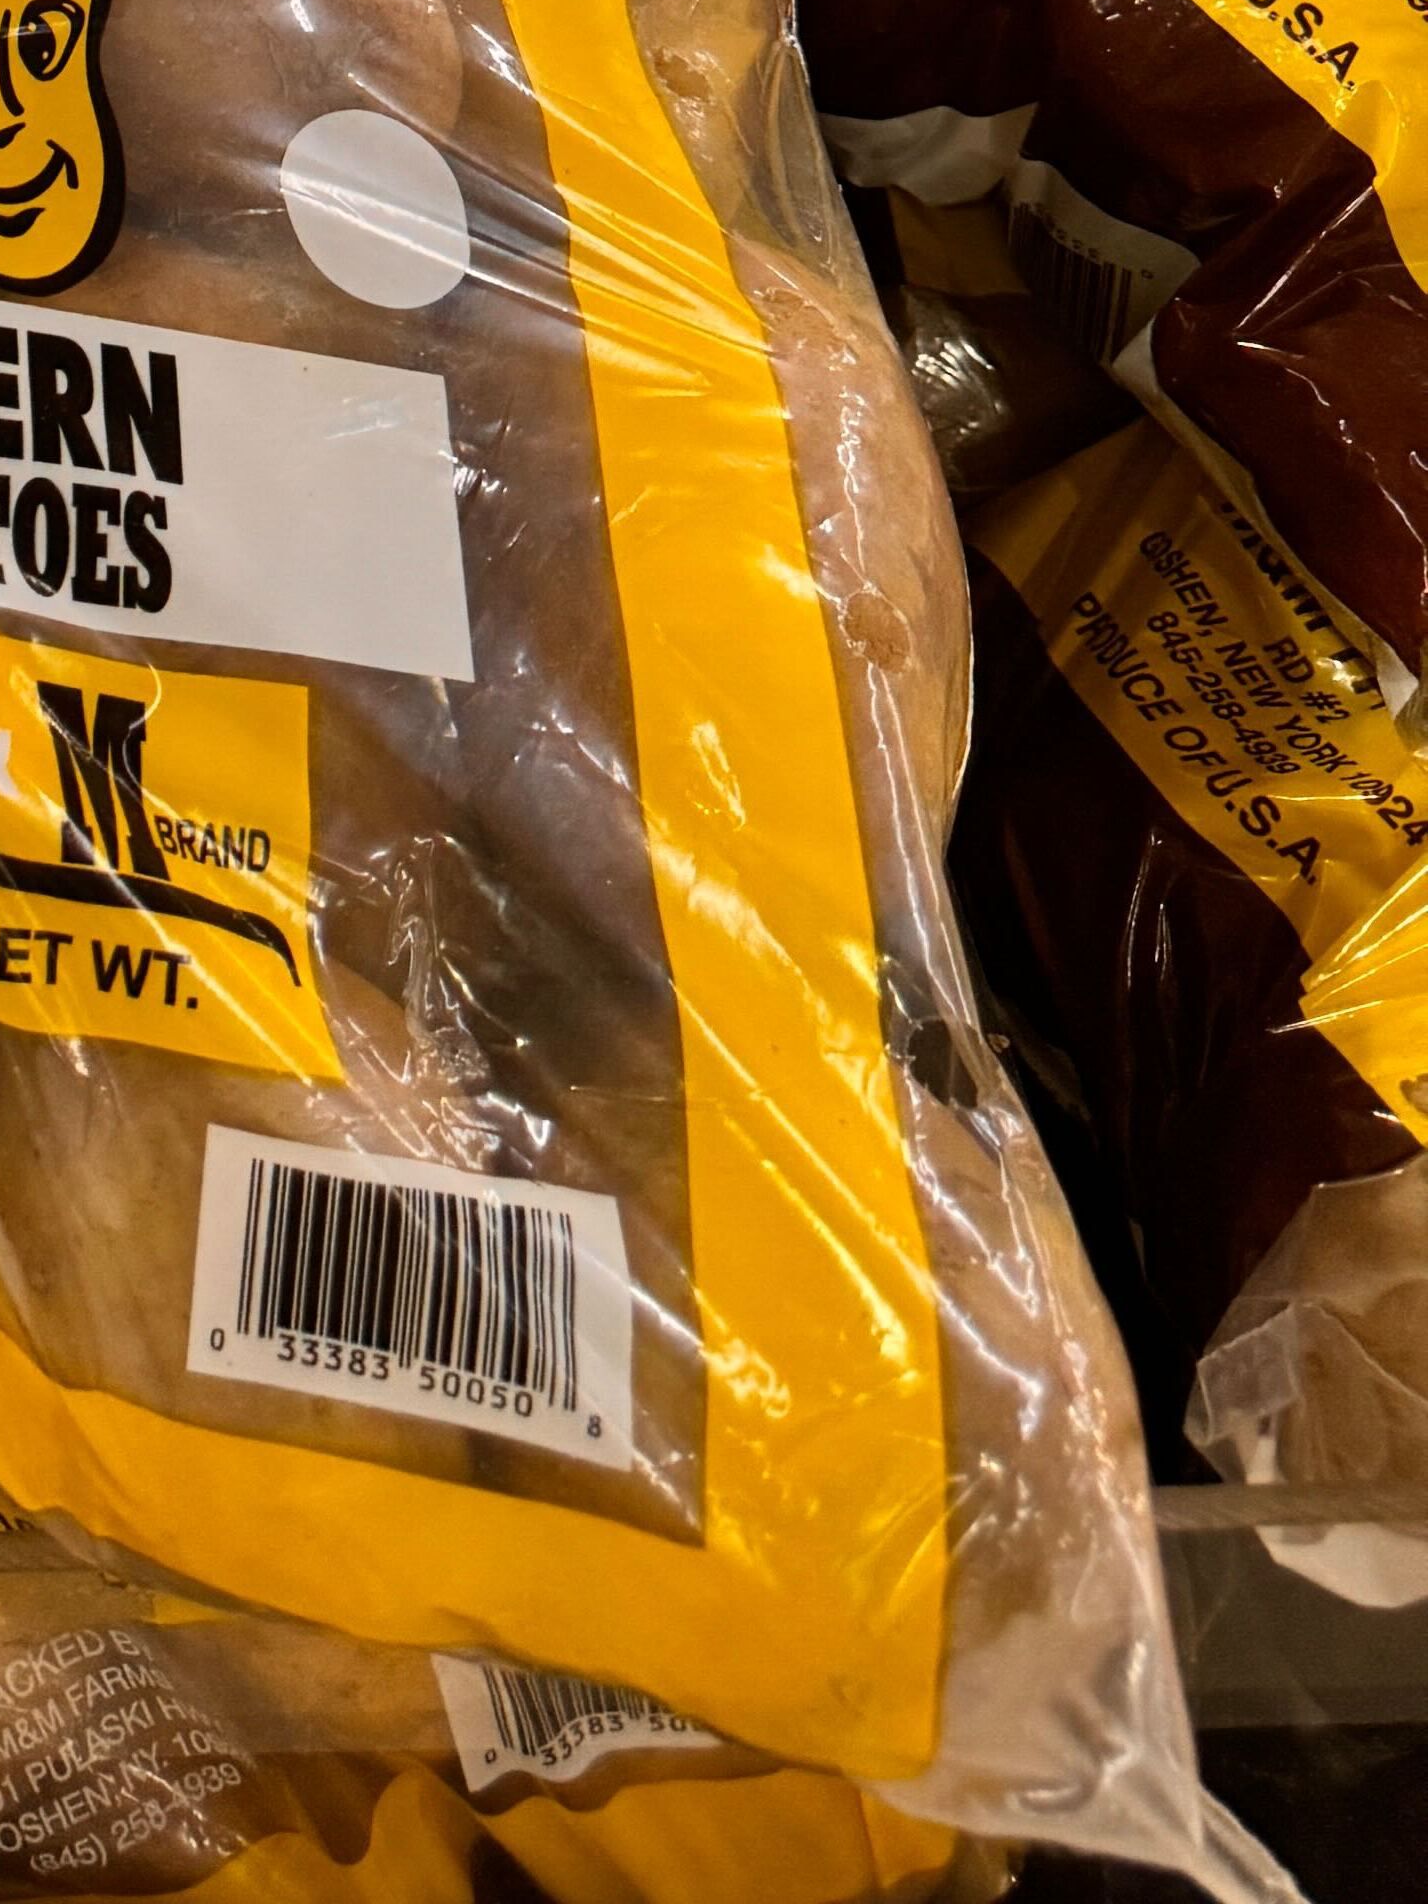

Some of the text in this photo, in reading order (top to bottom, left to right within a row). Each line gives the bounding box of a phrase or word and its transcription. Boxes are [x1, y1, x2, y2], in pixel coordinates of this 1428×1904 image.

[1146, 611, 1302, 776] 845-258-4939
[1215, 640, 1292, 710] NEW
[1274, 714, 1358, 775] YORK
[1262, 636, 1351, 726] RD #2
[34, 677, 170, 881] M
[157, 817, 272, 876] BRAND
[1164, 725, 1228, 771] OF
[1205, 770, 1321, 886] U.S.A.
[90, 942, 203, 1011] WT.
[209, 1327, 602, 1439] 0 33383 50050 8
[25, 1699, 155, 1793] PULASKI
[484, 1748, 498, 1765] 0
[541, 1713, 625, 1766] 33383
